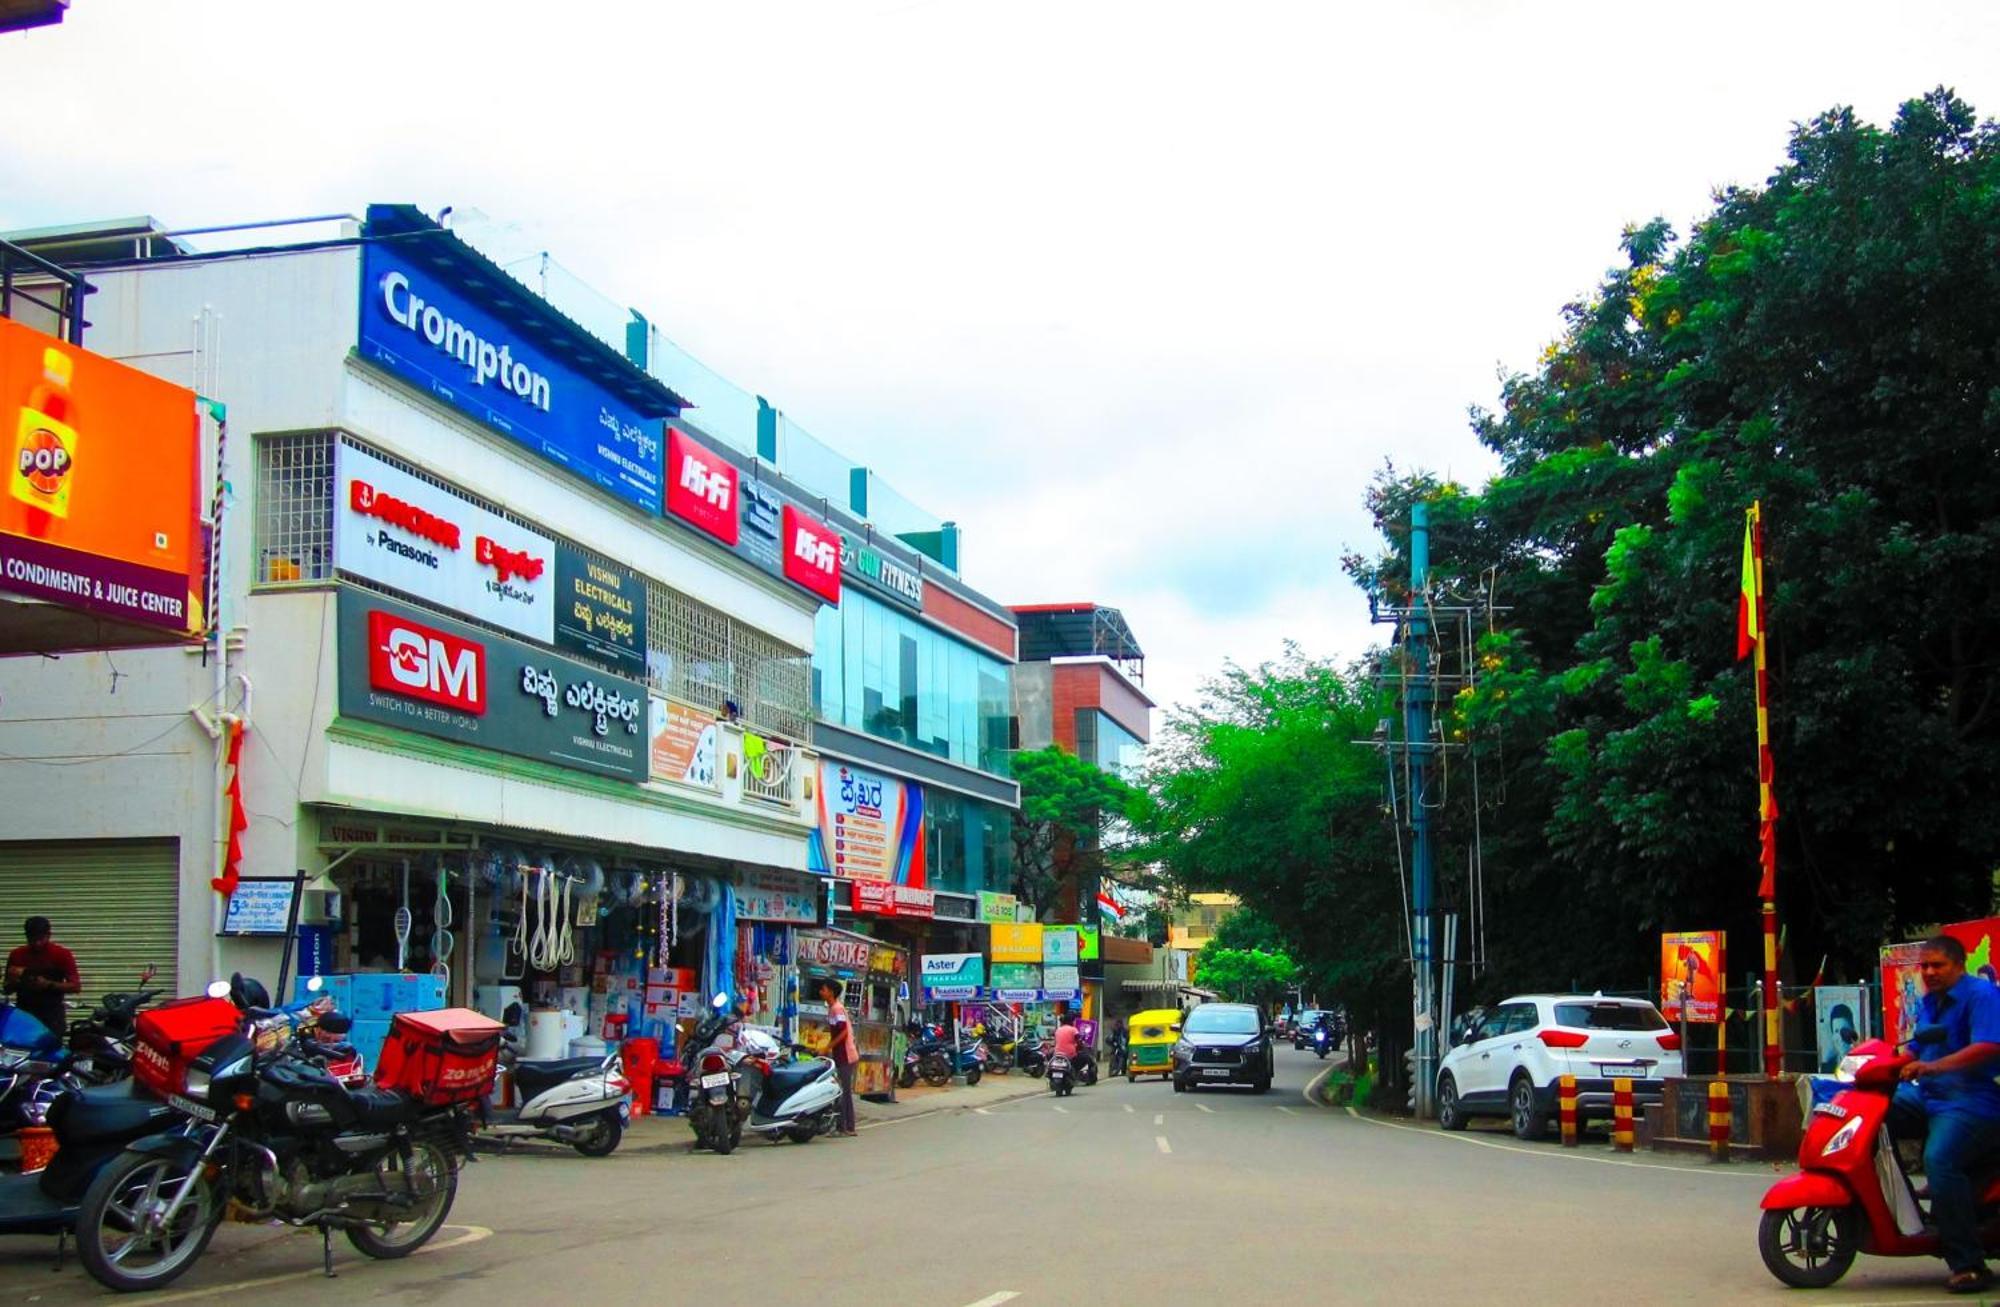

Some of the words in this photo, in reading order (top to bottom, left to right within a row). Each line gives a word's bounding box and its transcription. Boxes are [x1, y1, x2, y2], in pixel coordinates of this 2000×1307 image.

[383, 271, 550, 413] Crompton
[597, 443, 621, 465] VISHNU
[622, 457, 657, 485] ELECTRICALS
[378, 530, 438, 569] Panasonic
[7, 557, 91, 596] CONDIMENTS
[94, 580, 103, 600] &
[106, 582, 138, 608] JUICE
[141, 592, 183, 618] CENTER
[587, 563, 620, 590] VISHNU
[881, 559, 922, 602] FITNESS
[574, 578, 633, 615] ELECTRICALS
[388, 627, 477, 703] GM
[369, 693, 402, 711] SWITCH
[404, 702, 415, 716] TO
[416, 707, 423, 717] A
[425, 709, 450, 724] BETTER
[452, 715, 478, 731] WORLD
[572, 735, 595, 750] VISHNU
[596, 741, 633, 758] ELECTRICALS
[819, 940, 869, 966] SHAKE
[927, 959, 955, 970] Aster
